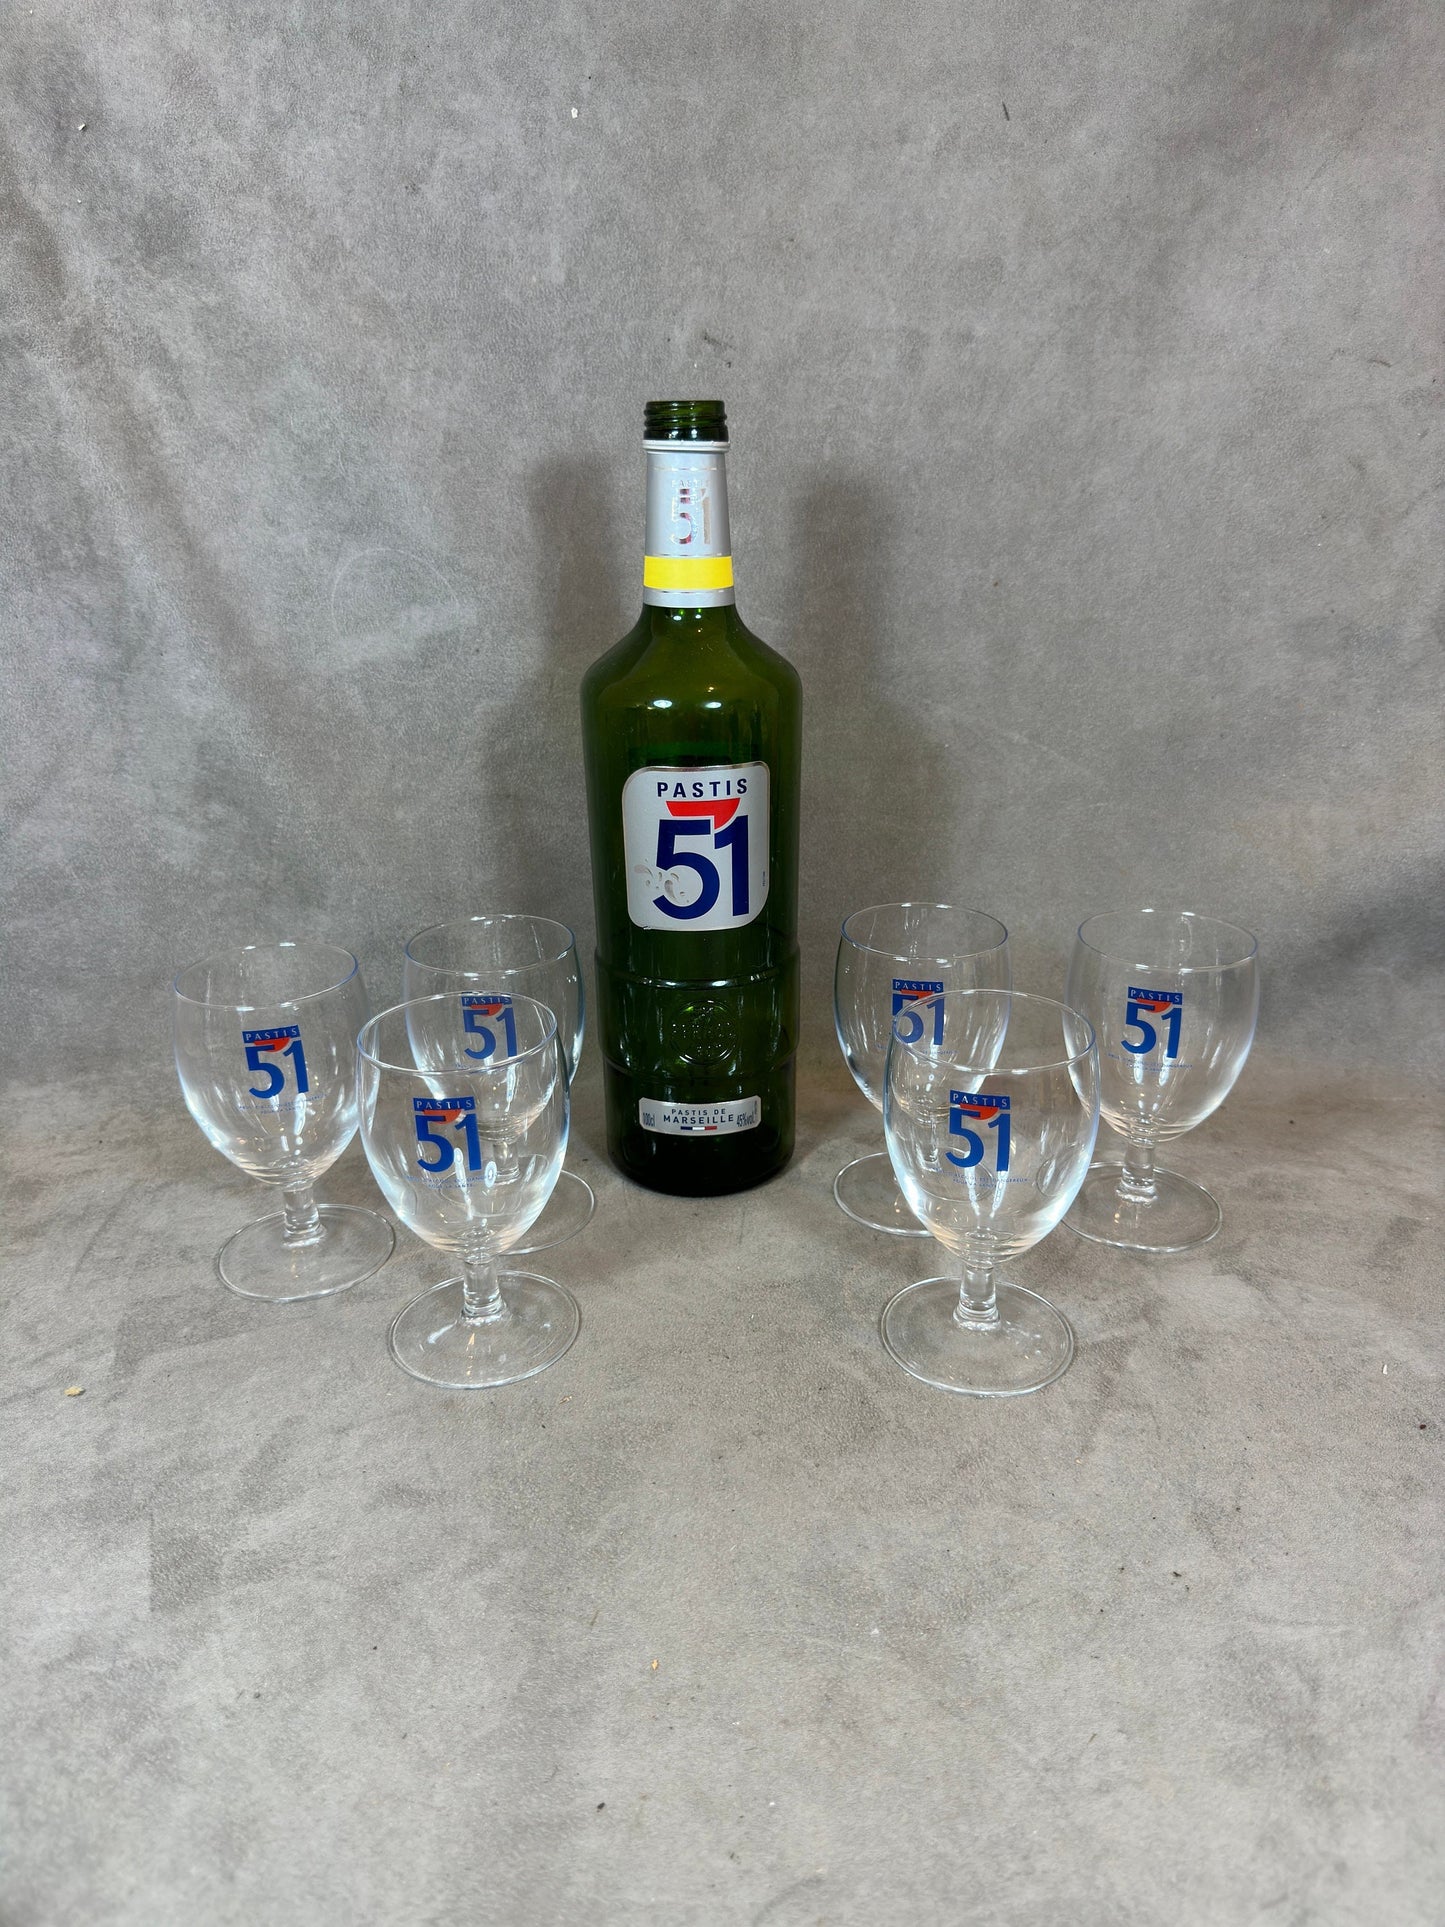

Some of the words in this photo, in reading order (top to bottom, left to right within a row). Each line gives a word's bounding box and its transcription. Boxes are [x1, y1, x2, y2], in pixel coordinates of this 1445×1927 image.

[670, 496, 711, 545] 51
[657, 778, 747, 798] PASTIS
[652, 815, 749, 919] 51
[895, 981, 941, 991] PASTIS
[1130, 989, 1180, 1002] PASTIS
[464, 997, 510, 1005] PASTIS
[892, 993, 945, 1046] 51
[245, 1027, 297, 1041] PASTIS
[463, 1007, 517, 1060] 51
[1121, 1001, 1182, 1059] 51
[245, 1039, 309, 1099] 51
[416, 1100, 472, 1110] PASTIS
[953, 1093, 1007, 1107] PASTIS
[663, 1113, 734, 1125] MARSEILLE
[671, 1108, 708, 1116] PASTIS
[415, 1113, 482, 1173] 51
[945, 1107, 1011, 1172] 51
